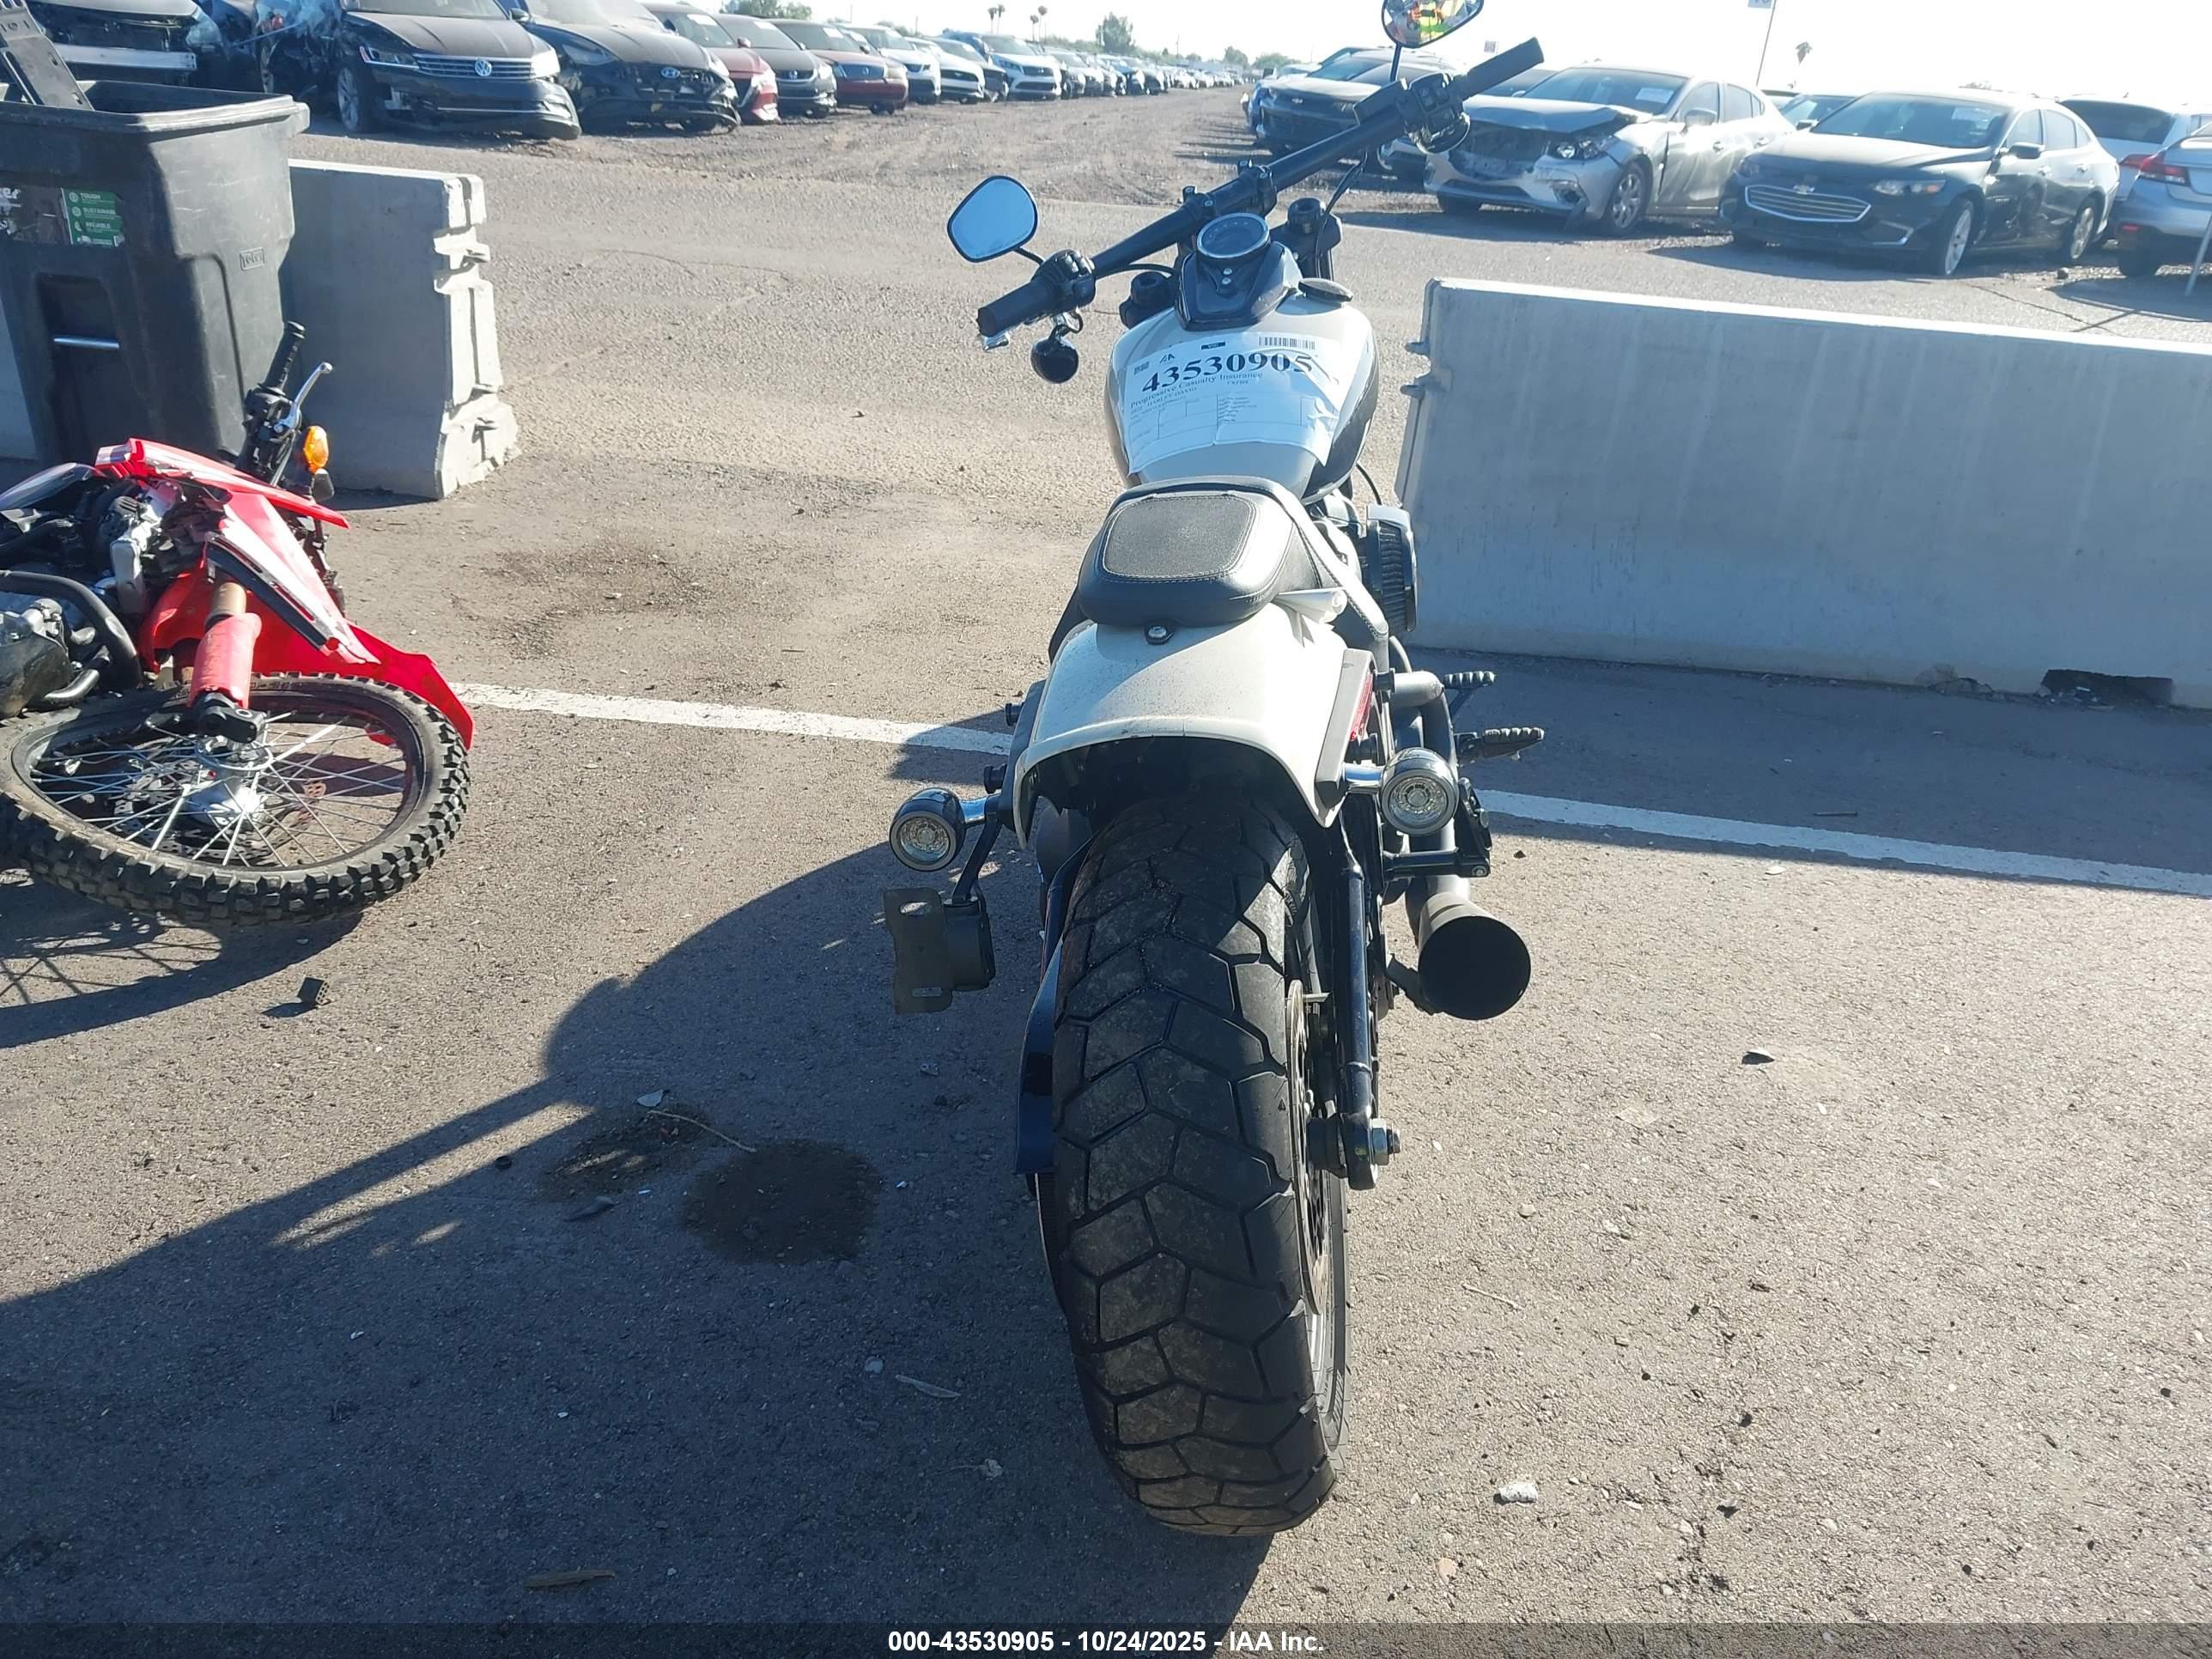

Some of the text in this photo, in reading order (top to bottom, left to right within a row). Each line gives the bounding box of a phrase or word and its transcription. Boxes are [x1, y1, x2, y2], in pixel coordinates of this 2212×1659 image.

[1130, 372, 1264, 409] Progressive Casualty Insurance
[1142, 352, 1313, 392] 43530905
